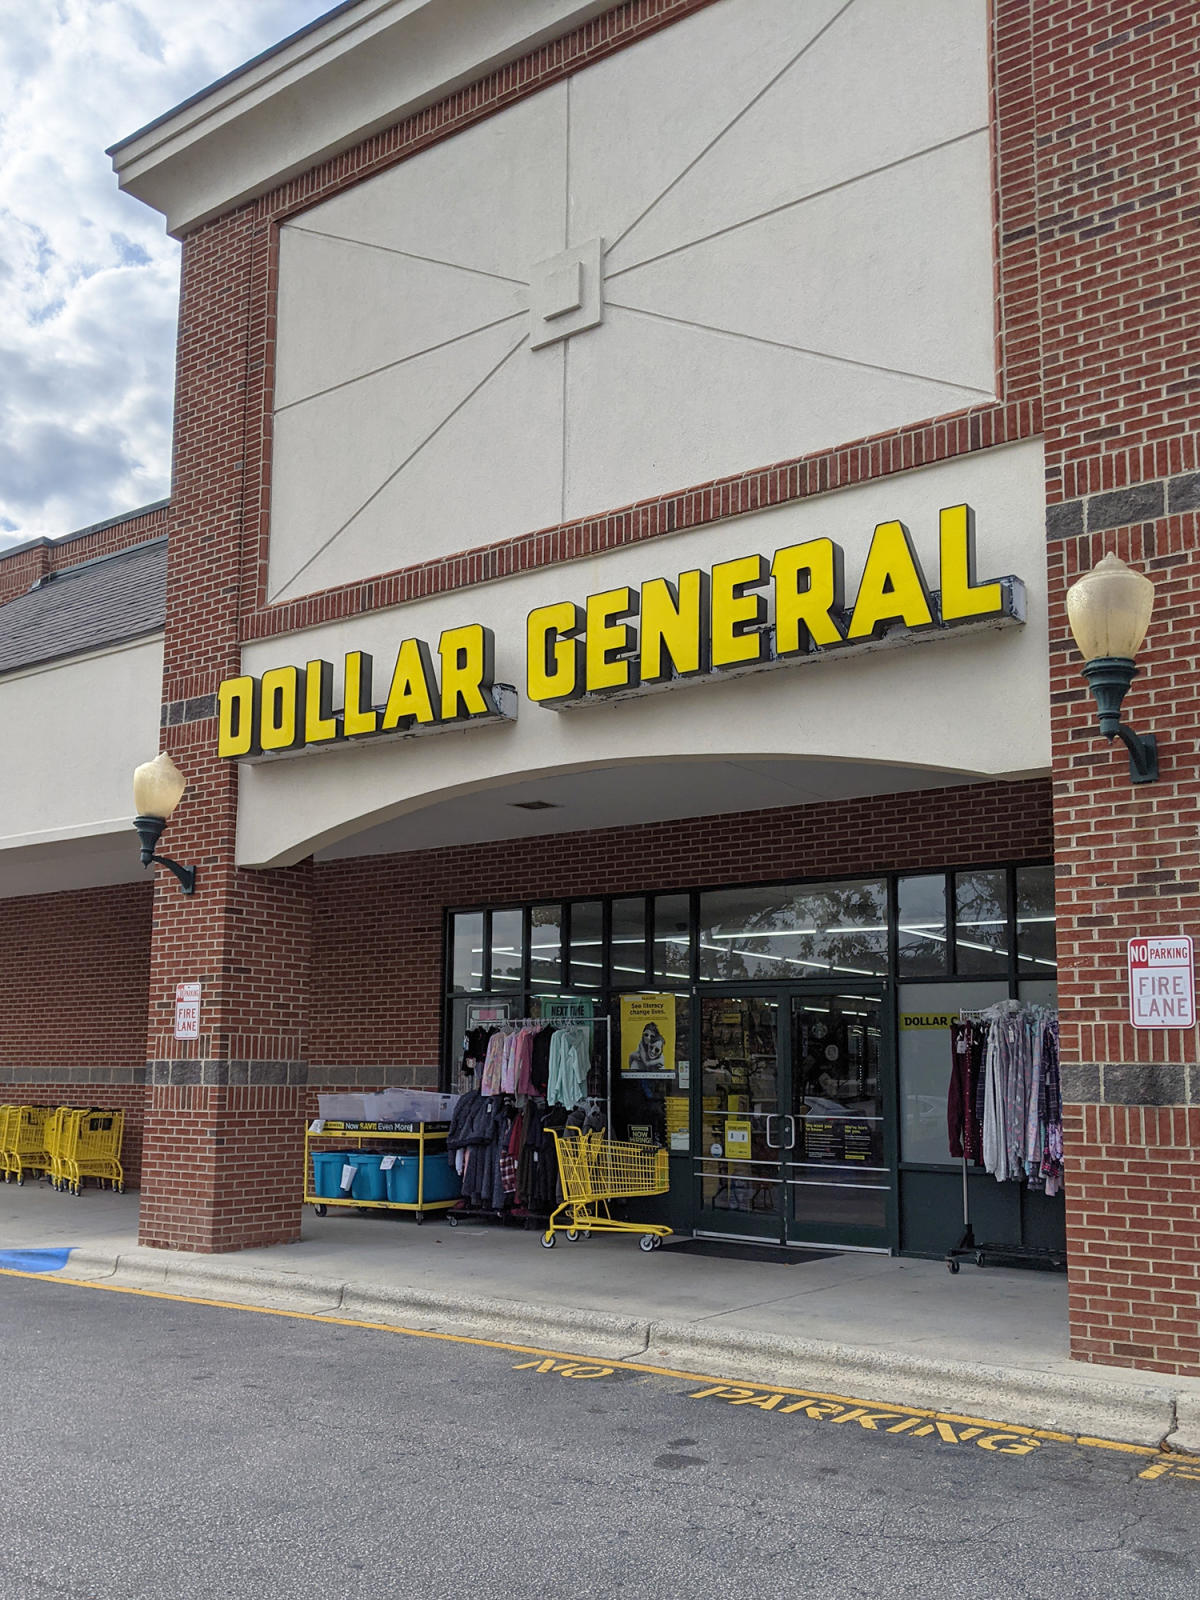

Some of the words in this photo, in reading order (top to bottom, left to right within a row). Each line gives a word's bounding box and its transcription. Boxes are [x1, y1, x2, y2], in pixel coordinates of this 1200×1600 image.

[216, 623, 489, 760] DOLLAR
[525, 503, 1004, 704] GENERAL
[1130, 945, 1148, 963] NO
[1149, 947, 1188, 960] PARKING
[1138, 976, 1185, 996] FIRE
[551, 1005, 568, 1017] NEXT
[569, 1005, 585, 1017] TIME
[643, 1002, 665, 1010] literacy
[1137, 998, 1189, 1017] LANE
[178, 1008, 197, 1019] FIRE
[177, 1020, 197, 1032] LANE
[904, 1016, 948, 1026] DOLLAR
[345, 1122, 359, 1130] Now
[377, 1122, 394, 1131] Even
[513, 1358, 615, 1379] NO
[689, 1385, 1043, 1457] PARKING
